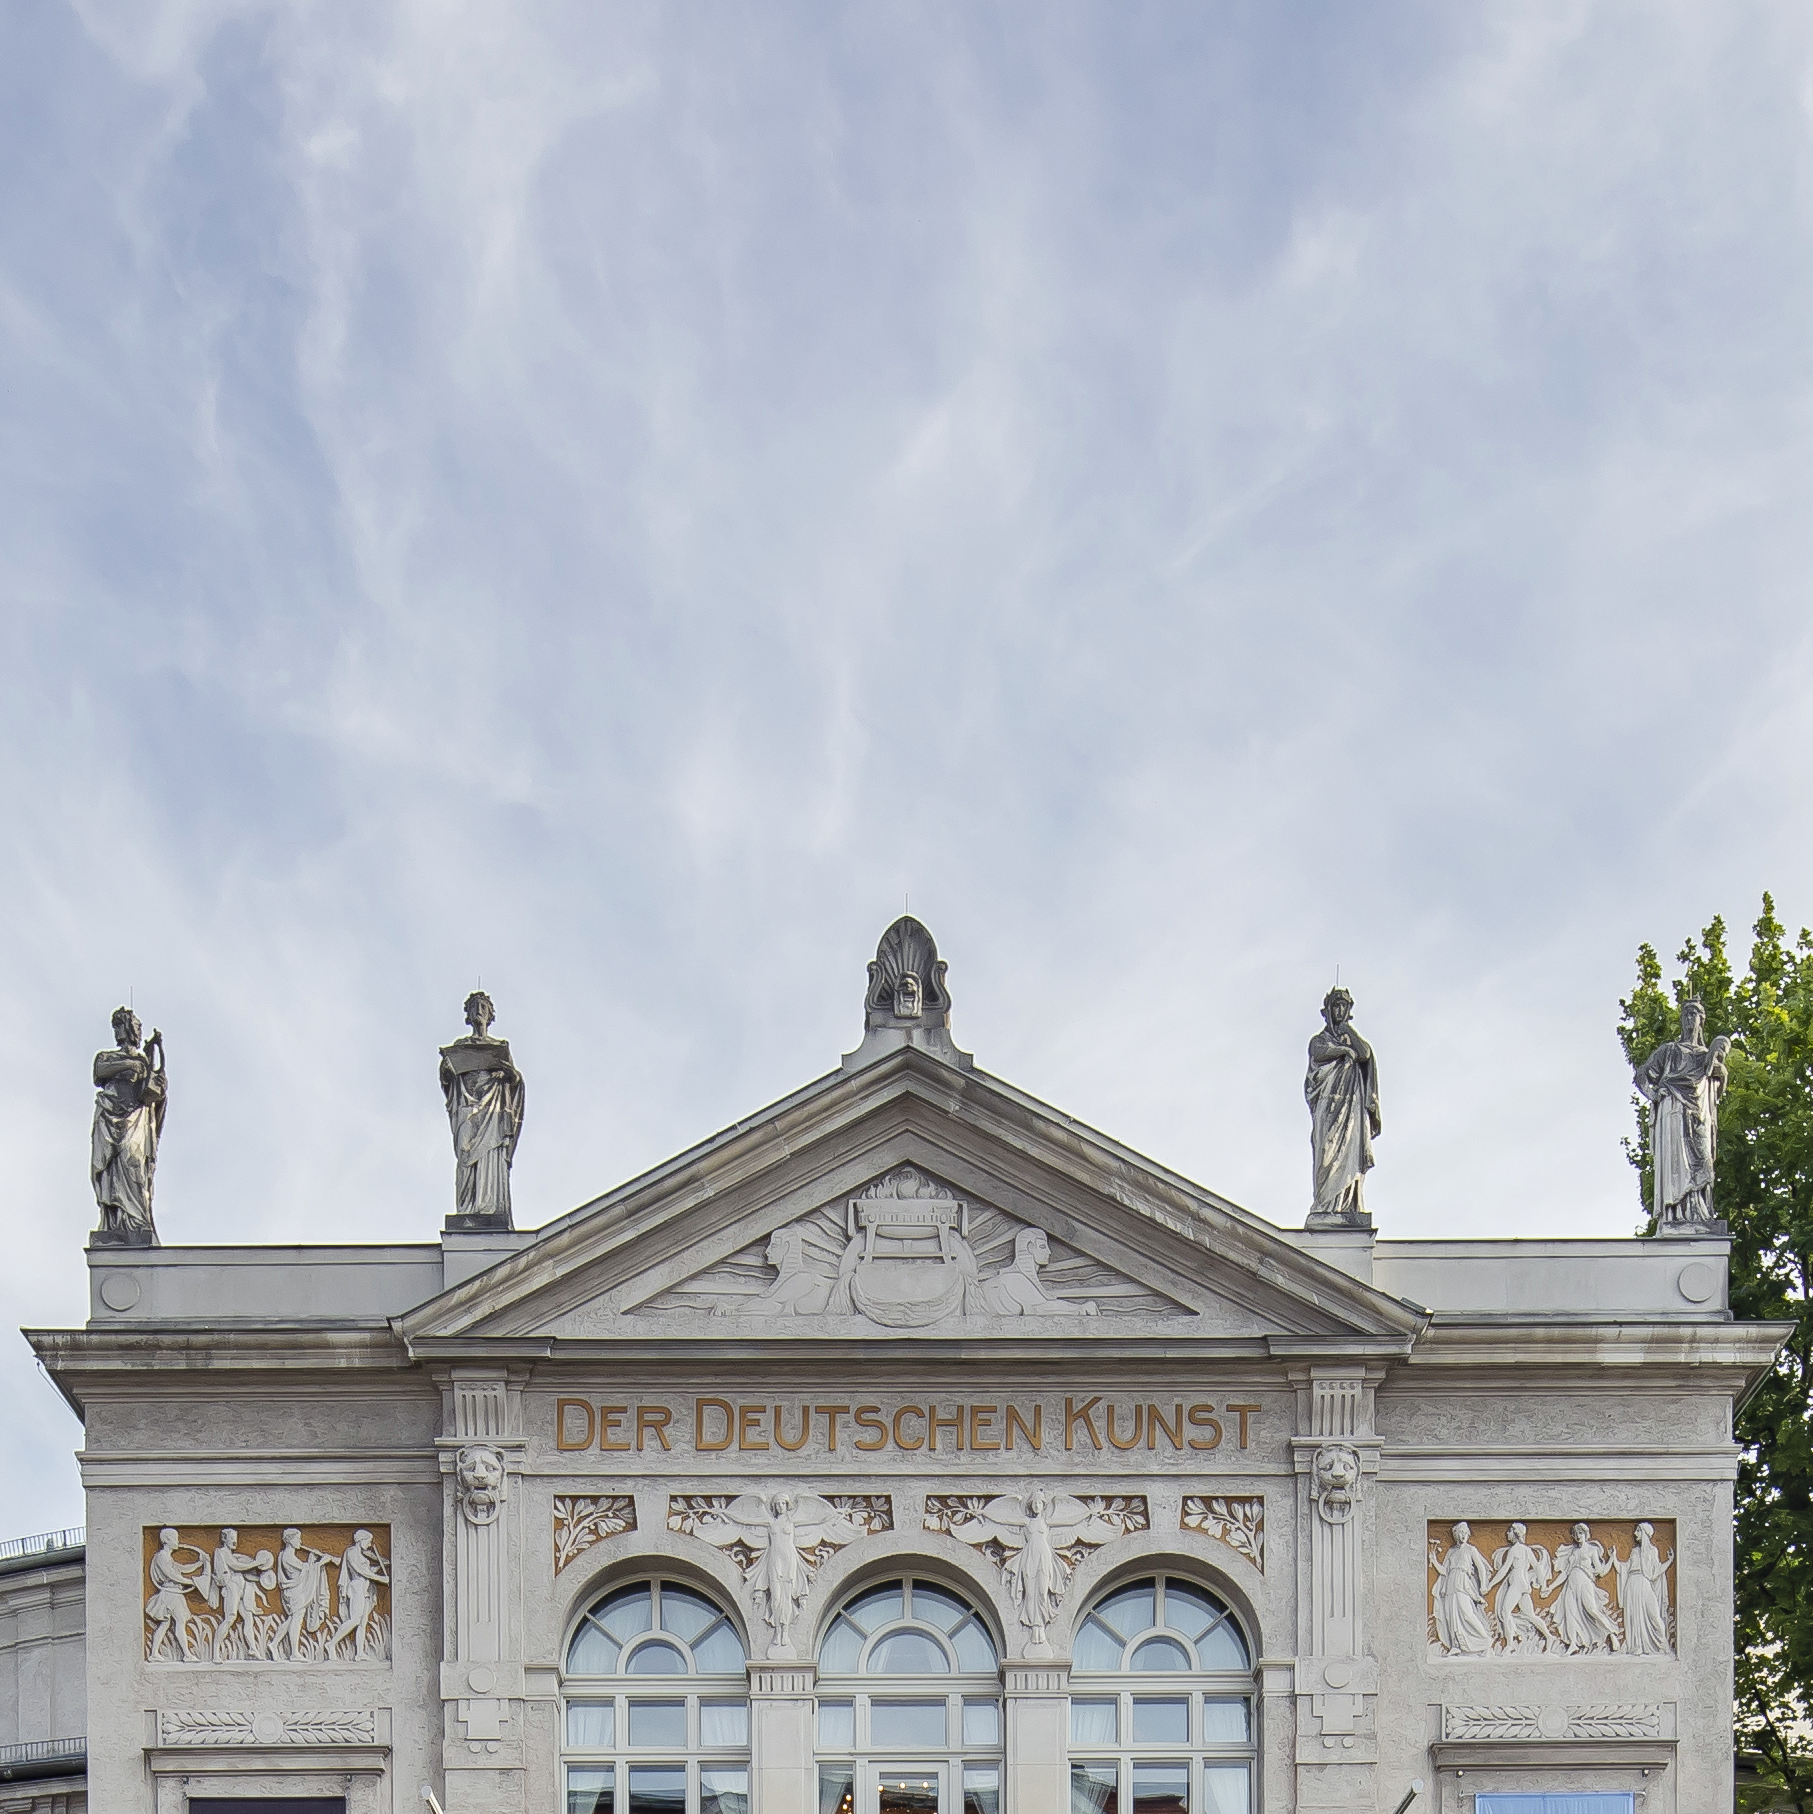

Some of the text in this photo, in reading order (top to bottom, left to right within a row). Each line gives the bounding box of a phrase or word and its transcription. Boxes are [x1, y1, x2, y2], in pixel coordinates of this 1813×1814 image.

[556, 1396, 1263, 1452] DER DEUTSCHEN KUNST
